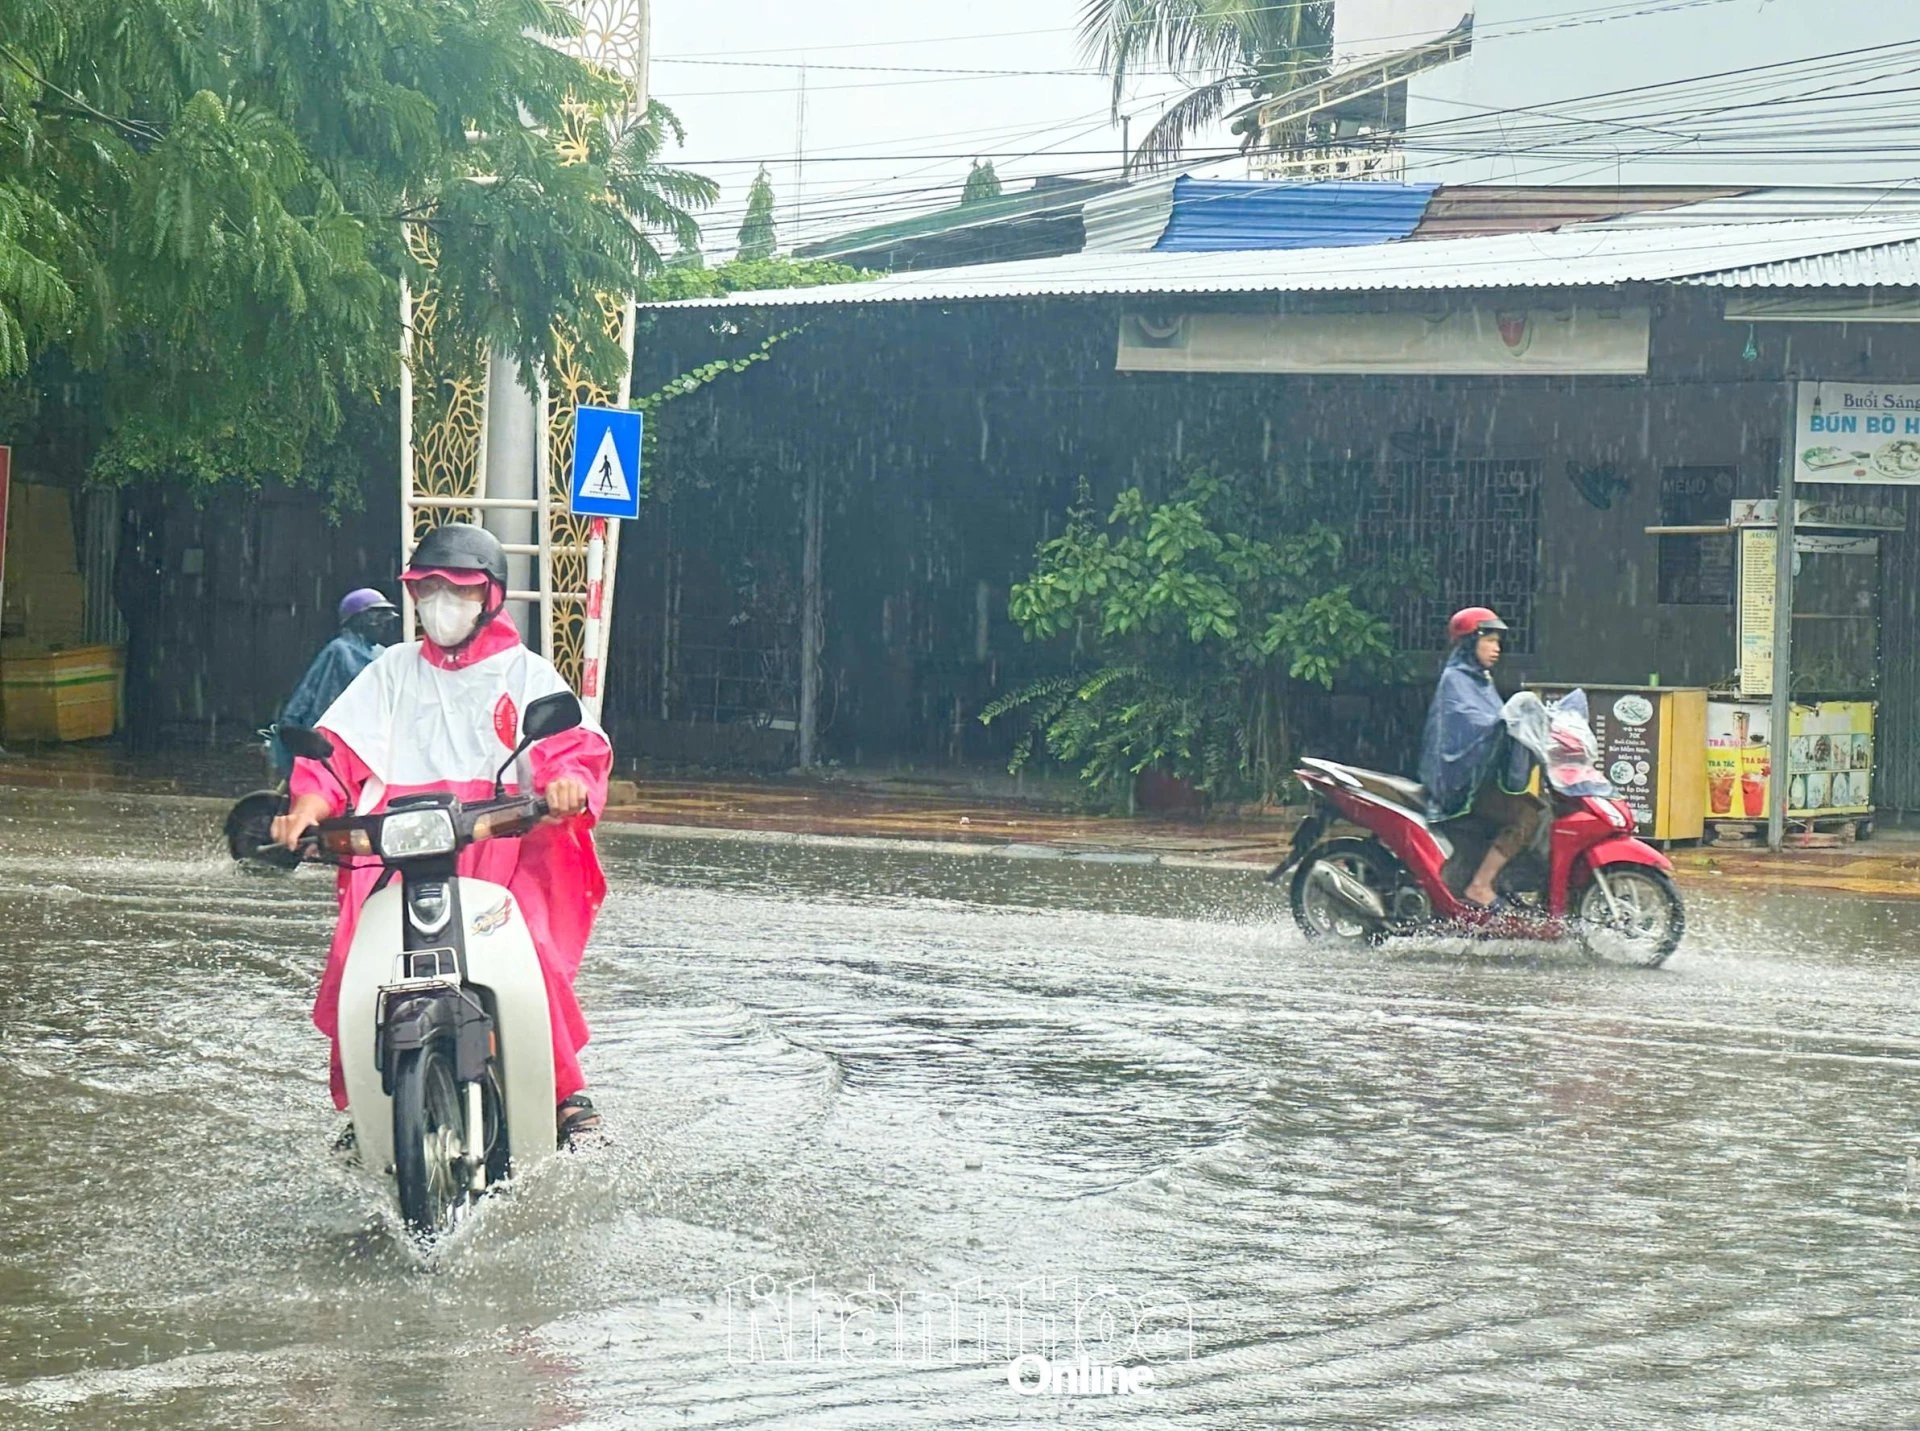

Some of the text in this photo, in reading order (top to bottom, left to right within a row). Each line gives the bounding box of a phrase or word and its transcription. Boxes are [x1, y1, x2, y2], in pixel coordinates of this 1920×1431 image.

[1843, 390, 1878, 407] Buổi
[1810, 412, 1857, 433] BÚN
[1866, 413, 1895, 434] BÒ
